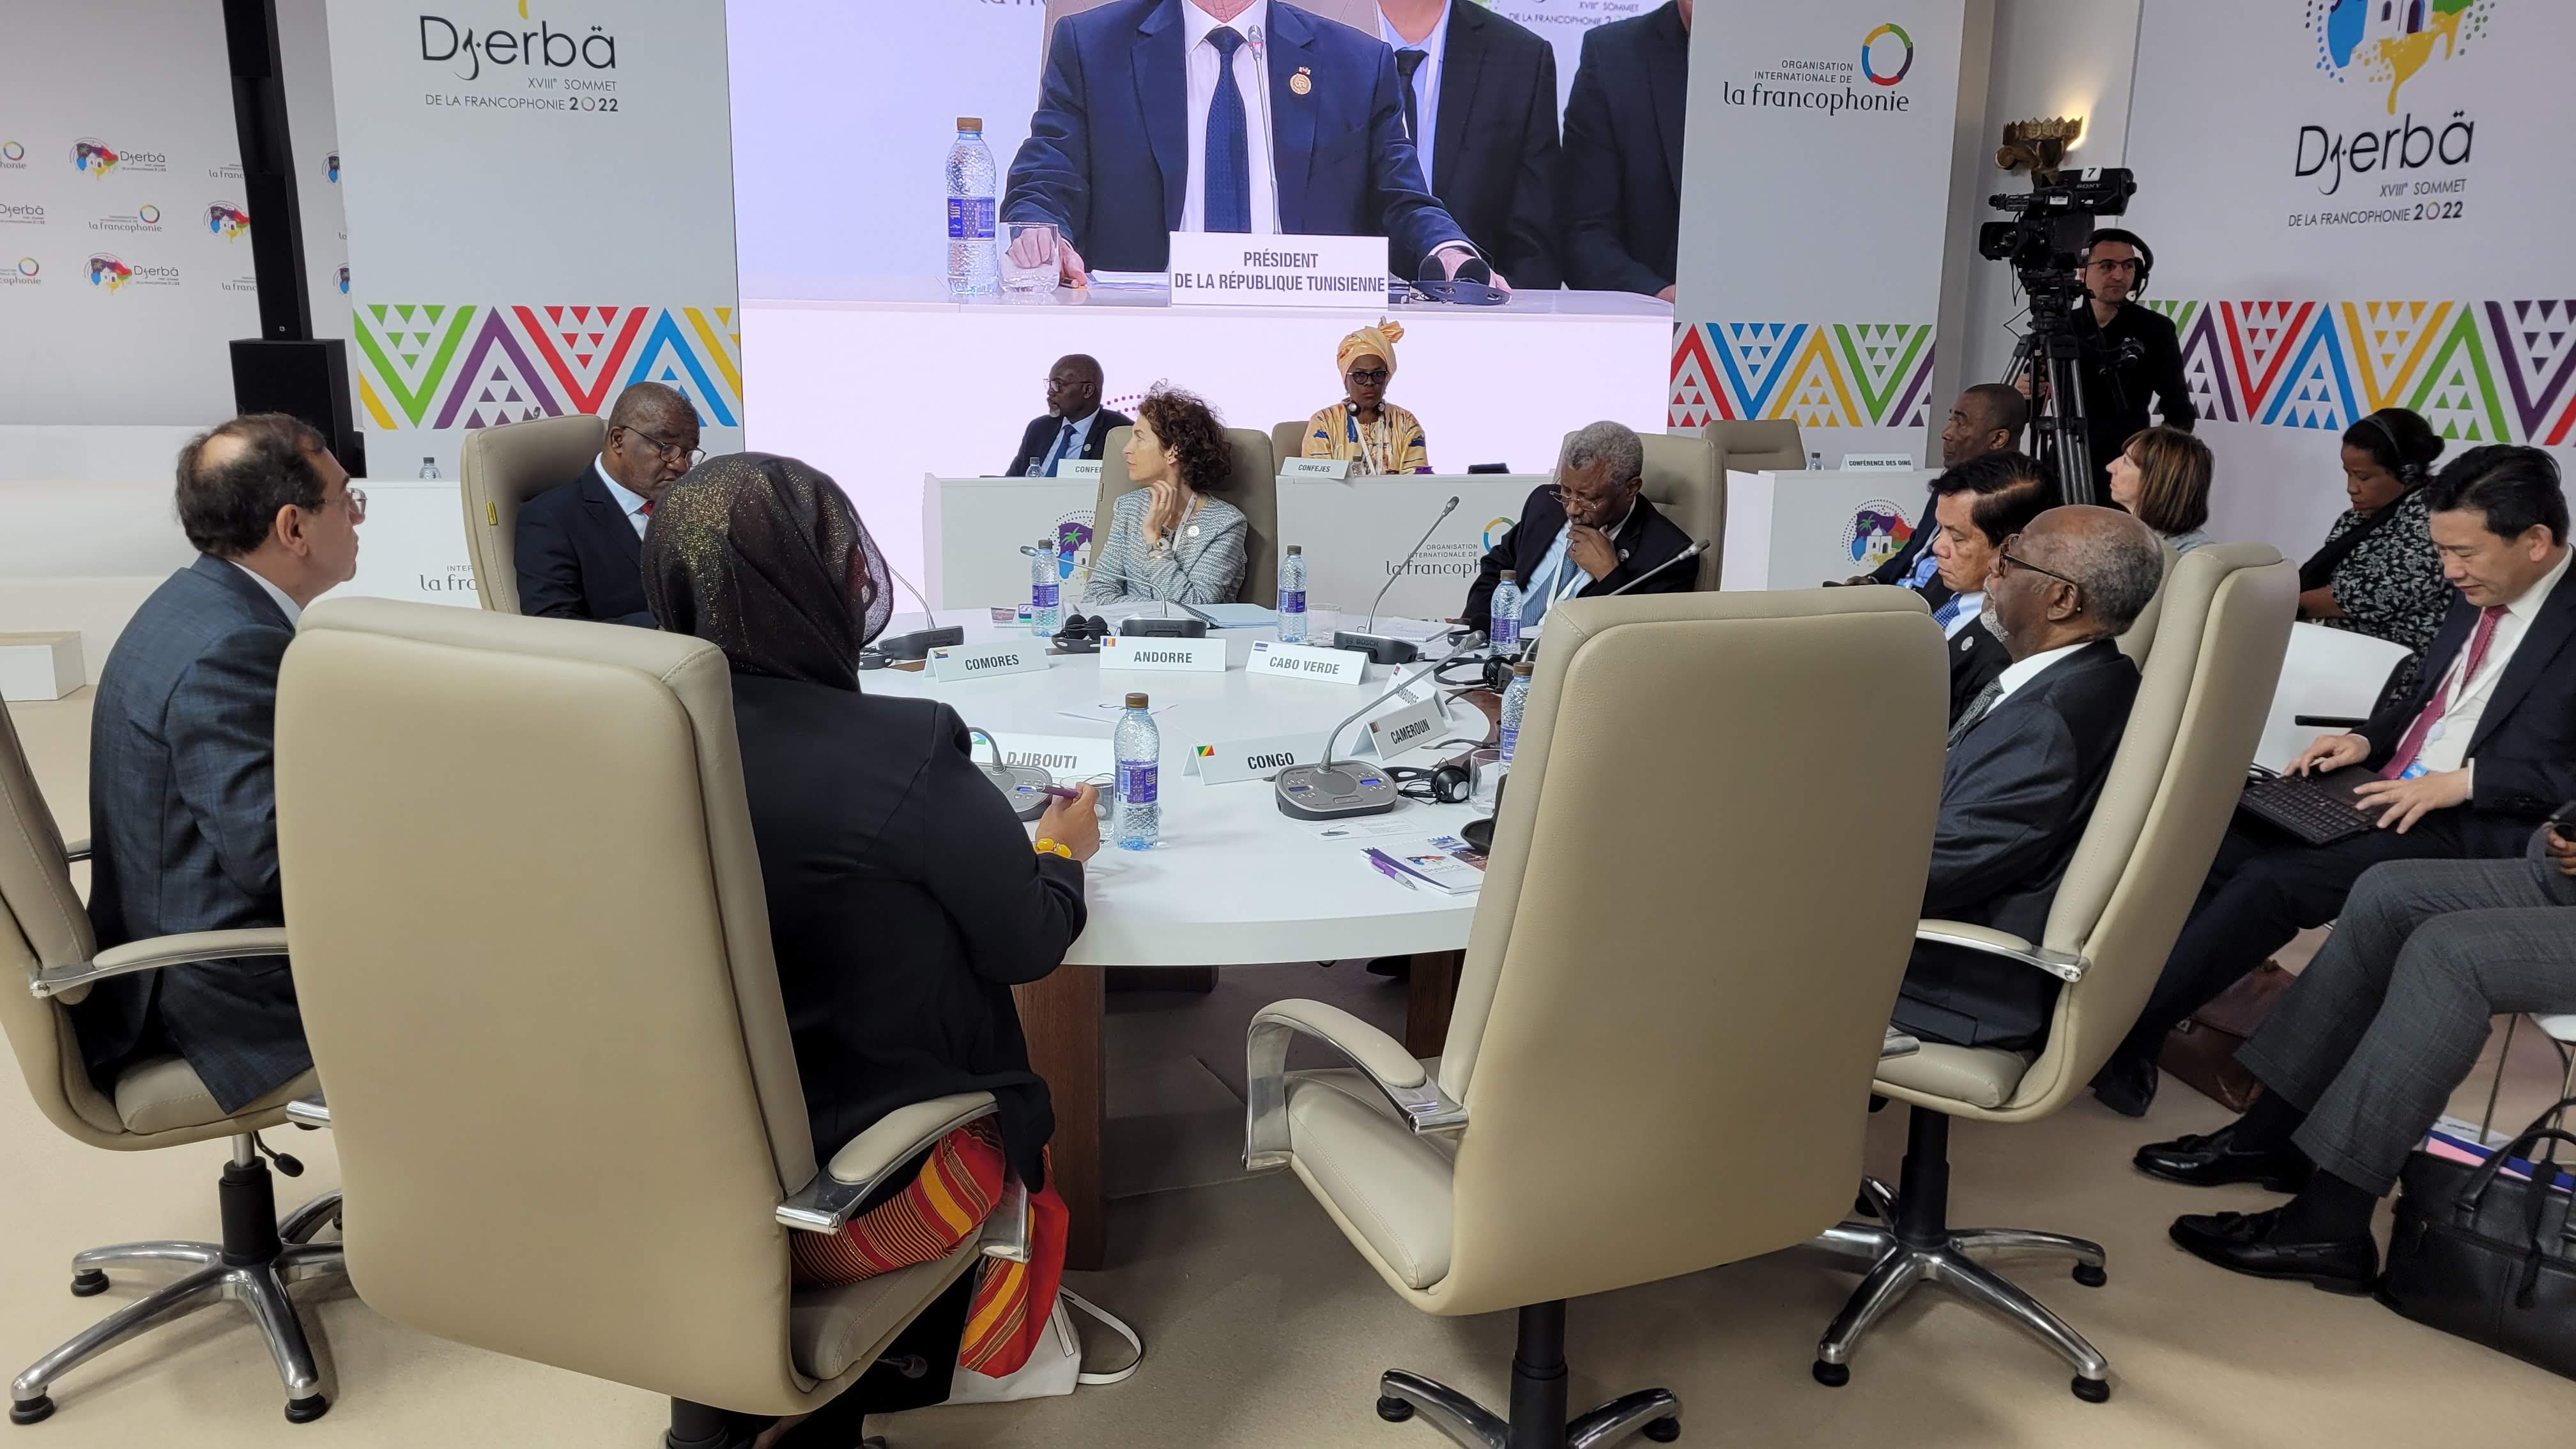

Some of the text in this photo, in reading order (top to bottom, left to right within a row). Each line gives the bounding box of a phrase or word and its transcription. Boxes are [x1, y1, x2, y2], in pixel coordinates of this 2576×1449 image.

[1781, 60, 1853, 71] ORGANISATION
[564, 79, 617, 91] SOMMET
[1754, 71, 1852, 83] INTERNATIONALE DE
[425, 95, 618, 112] DE LA FRANCOPHONIE 2022
[1724, 81, 1909, 116] la francophonie
[2088, 167, 2097, 178] 7
[2413, 179, 2467, 195] SOMMET
[2288, 201, 2463, 227] DE LA FRANCOPHONIE 2022
[89, 221, 162, 233] la francophonie
[1243, 248, 1319, 268] PRÉSIDENT
[1174, 270, 1385, 292] DE LA RÉPUBLIQUE TUNISIENNE
[1298, 464, 1331, 473] CONFEJES
[1385, 560, 1402, 576] la
[419, 574, 441, 592] la
[1356, 638, 1379, 647] BOSCH
[965, 654, 1020, 671] COMORES
[1133, 651, 1192, 663] ANDORRE
[1269, 656, 1340, 675] CABO VERDE
[1390, 718, 1430, 744] CAMEROUN
[1006, 751, 1077, 769] DJIBOUTI
[1247, 752, 1294, 769] CONGO
